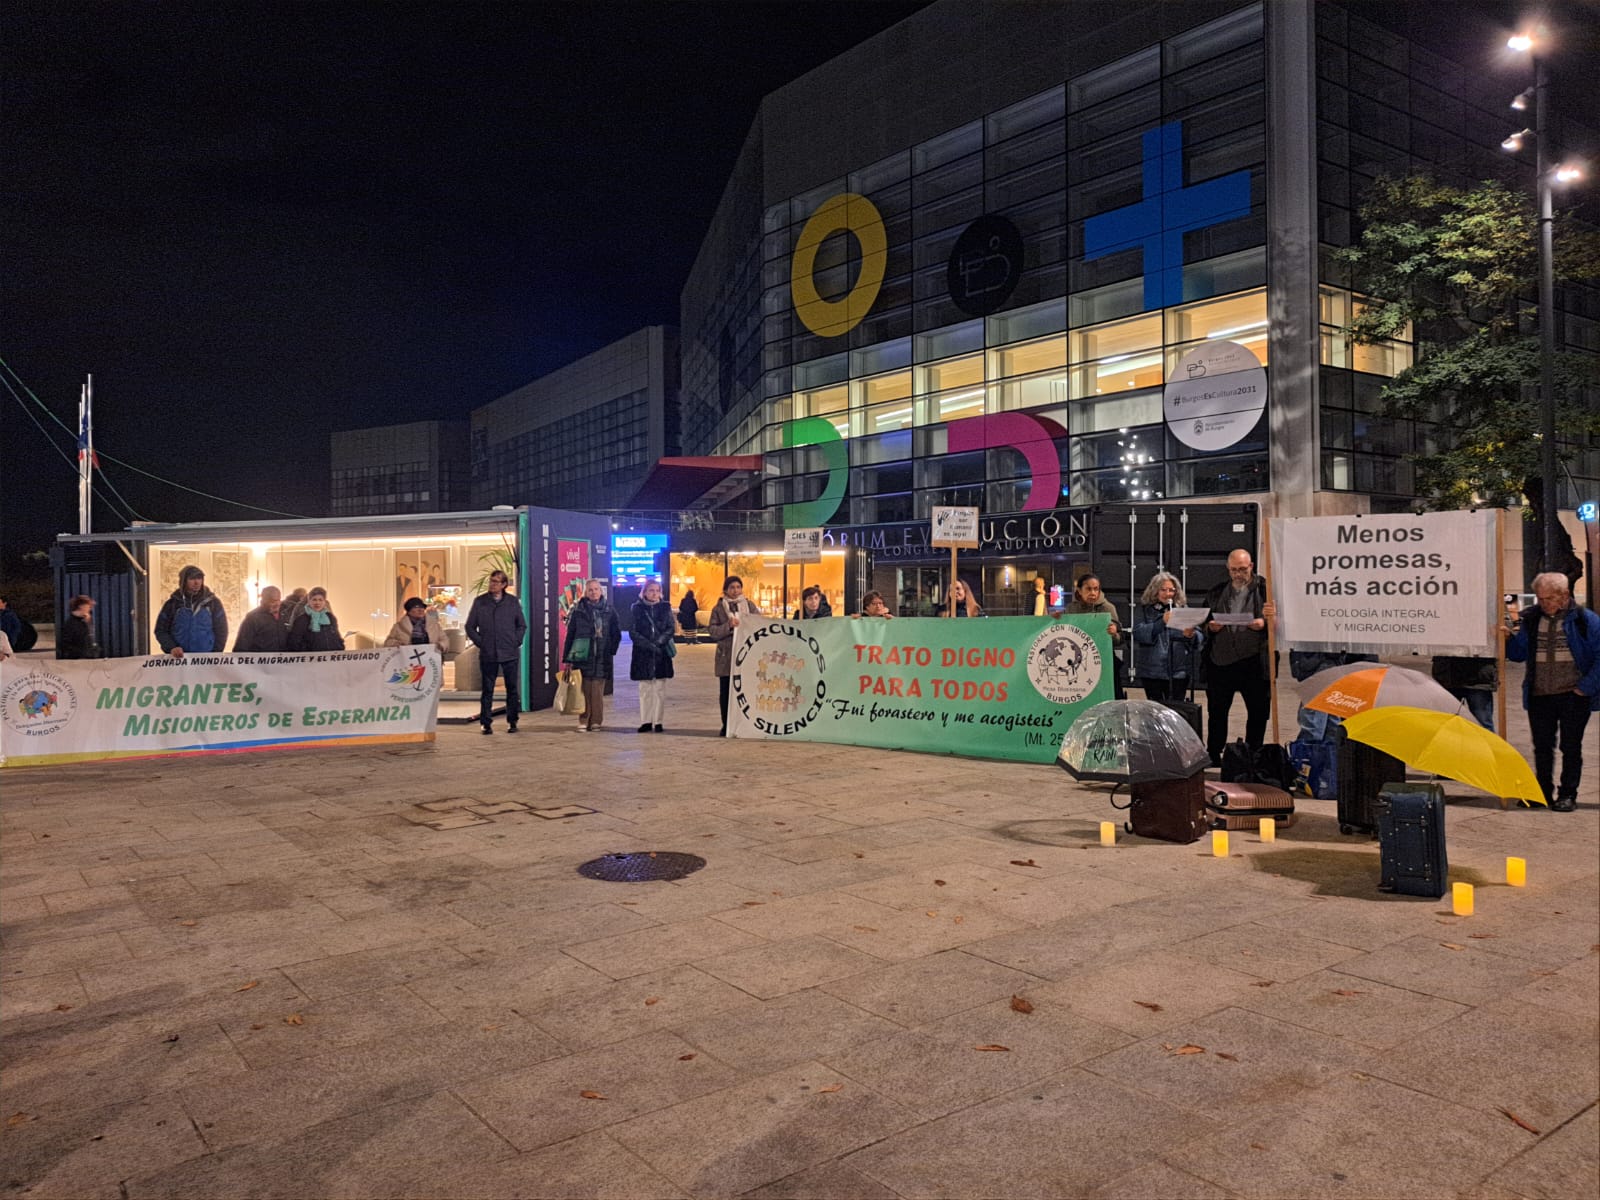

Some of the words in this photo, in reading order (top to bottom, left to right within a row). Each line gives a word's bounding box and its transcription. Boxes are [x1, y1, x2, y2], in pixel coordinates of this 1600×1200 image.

[1174, 385, 1257, 407] #BurgosEsCultura2031
[822, 529, 886, 549] ÓRUM
[904, 511, 1088, 548] EVUCIÓN
[1337, 524, 1424, 544] Menos
[883, 544, 967, 557] CONGRES
[995, 534, 1086, 551] AUDITORIO
[1312, 552, 1451, 575] promesas,
[1305, 576, 1357, 596] más
[1366, 575, 1459, 596] acción
[1320, 608, 1378, 618] ECOLOGÍA
[1381, 609, 1440, 619] INTEGRAL
[1334, 623, 1342, 632] Y
[1344, 623, 1426, 633] MIGRACIONES
[735, 623, 826, 674] CIRCULOS
[853, 644, 932, 667] TRATO
[941, 647, 1016, 669] DIGNO
[1028, 633, 1048, 665] PASTORAL
[1050, 625, 1065, 633] CON
[1068, 625, 1101, 665] INMIGRANTES
[142, 658, 188, 668] JORNADA
[191, 656, 234, 666] MUNDIAL
[237, 656, 255, 665] DEL
[257, 656, 306, 665] MIGRANTE
[308, 655, 315, 663] Y
[330, 652, 380, 662] REFUGIADO
[96, 682, 263, 710] MIGRANTES,
[733, 674, 751, 720] DEL
[858, 675, 923, 698] PARA
[930, 678, 1009, 702] TODOS
[1046, 692, 1083, 703] BURGOS
[753, 679, 826, 736] SILENCIO
[870, 702, 935, 723] forastero
[941, 711, 949, 727] y
[954, 712, 975, 723] me
[123, 712, 260, 737] MISIONEROS
[267, 711, 293, 728] DE
[302, 704, 411, 727] ESPERANZA
